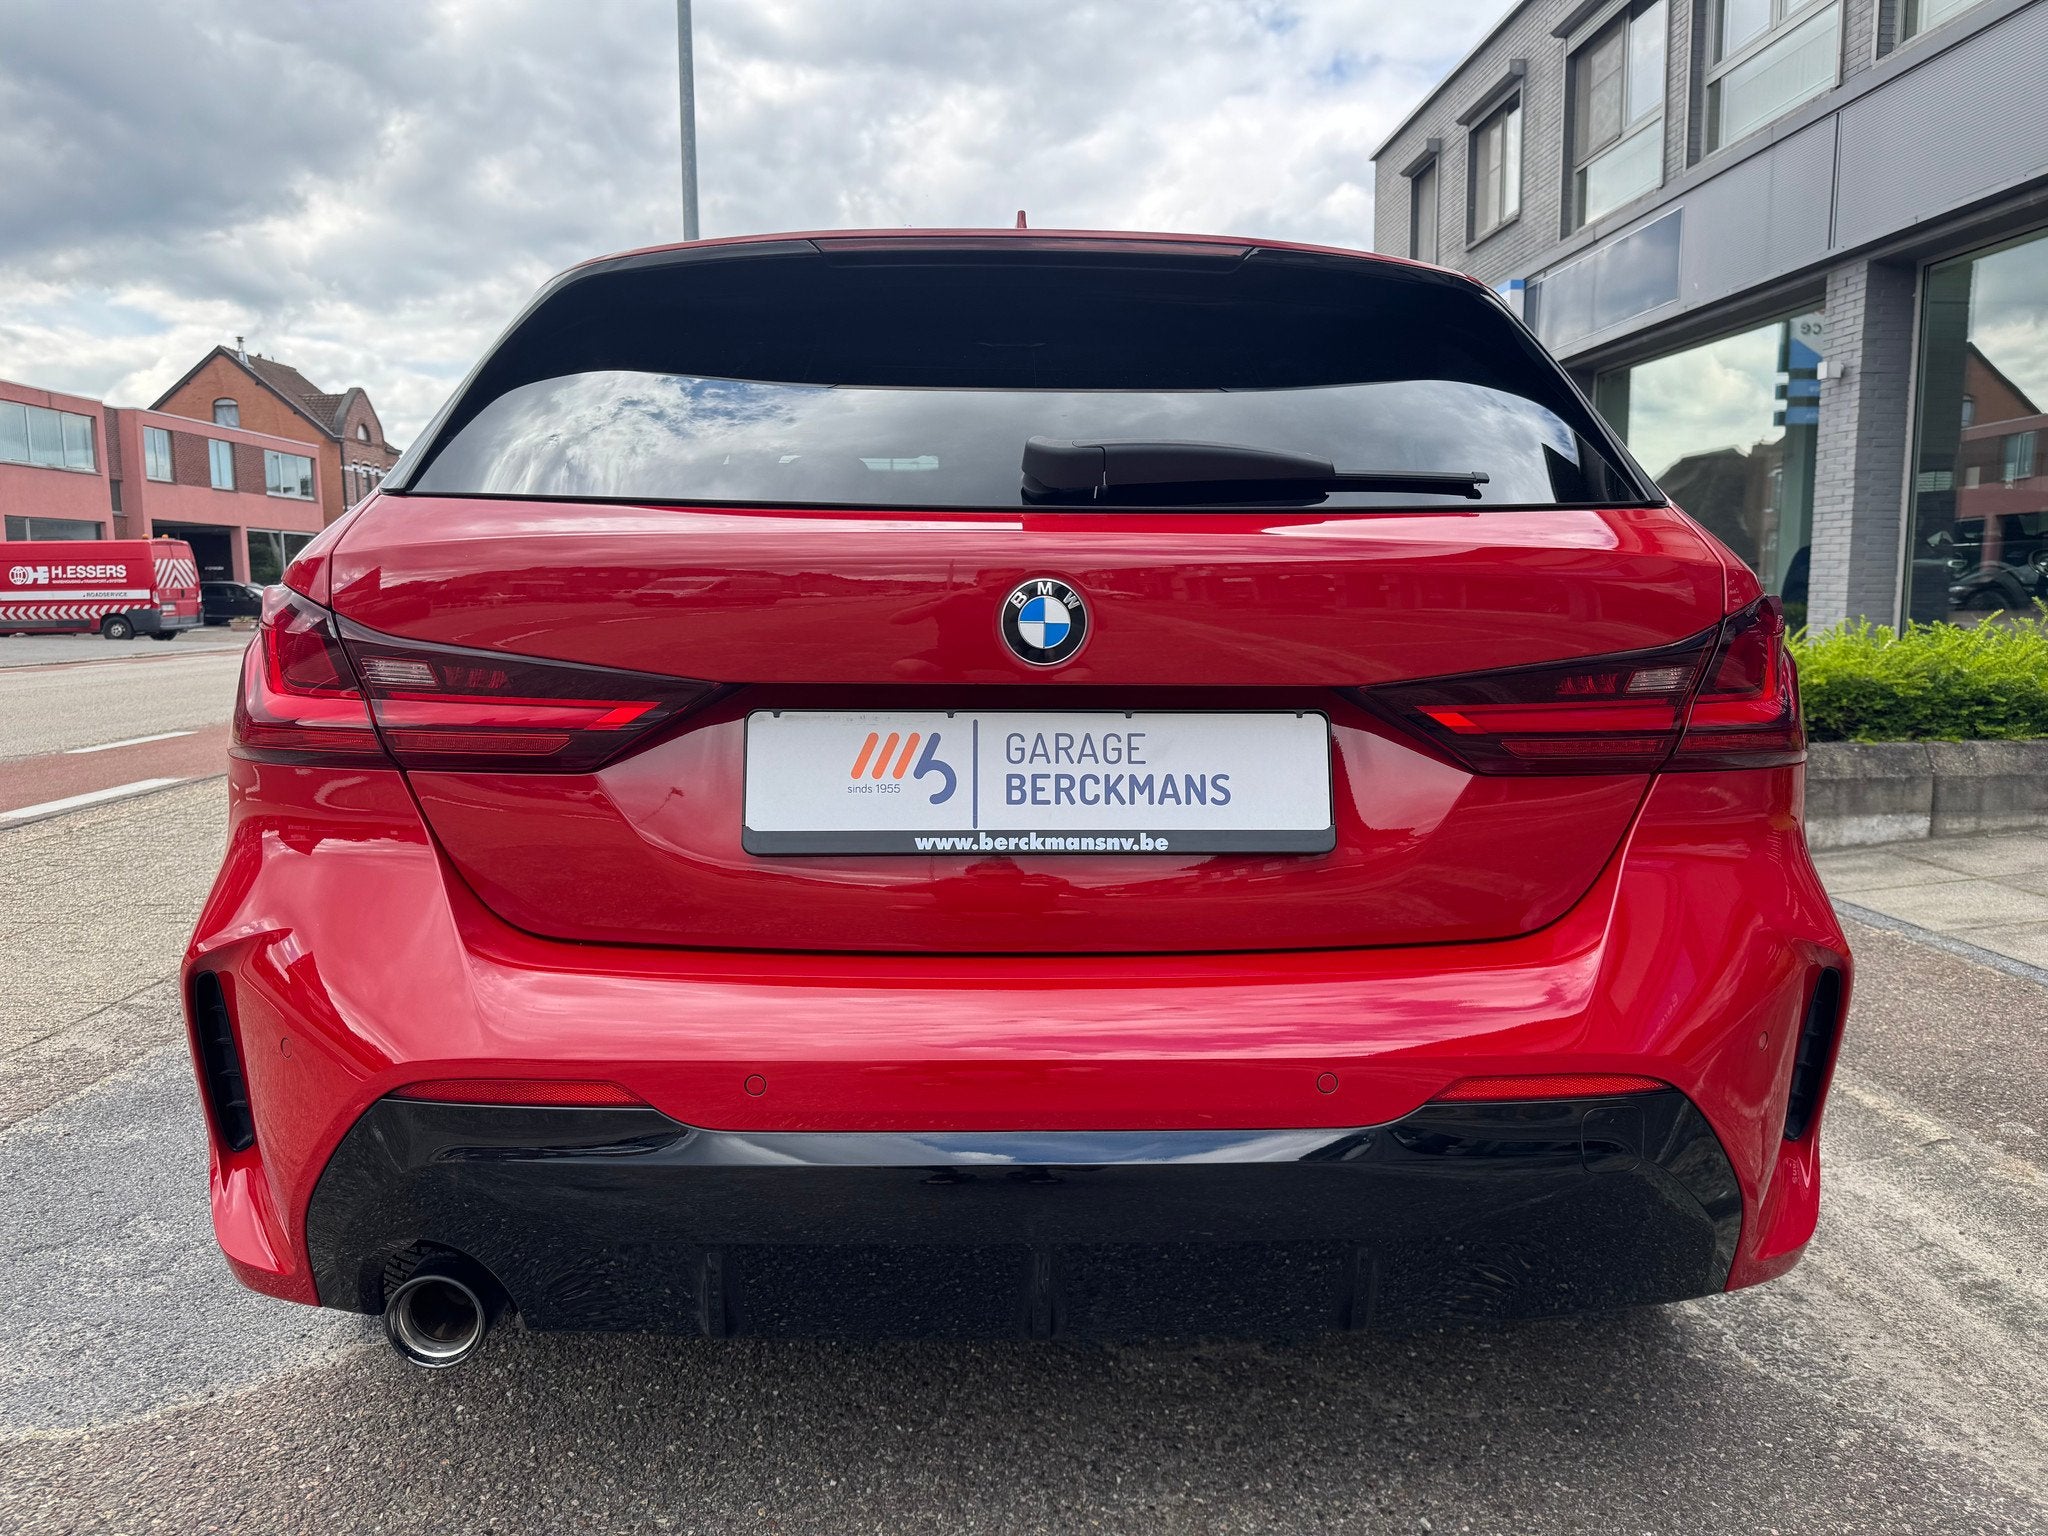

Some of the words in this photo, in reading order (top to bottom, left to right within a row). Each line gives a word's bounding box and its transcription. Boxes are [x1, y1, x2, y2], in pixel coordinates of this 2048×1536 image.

[51, 564, 127, 578] H.ESSERS
[1010, 581, 1081, 610] BMW
[1006, 732, 1147, 765] GARAGE
[847, 783, 873, 794] sinds
[876, 783, 901, 794] 1955
[1005, 773, 1232, 806] BERCKMANS
[914, 832, 1169, 851] www.berckmansnv.be
